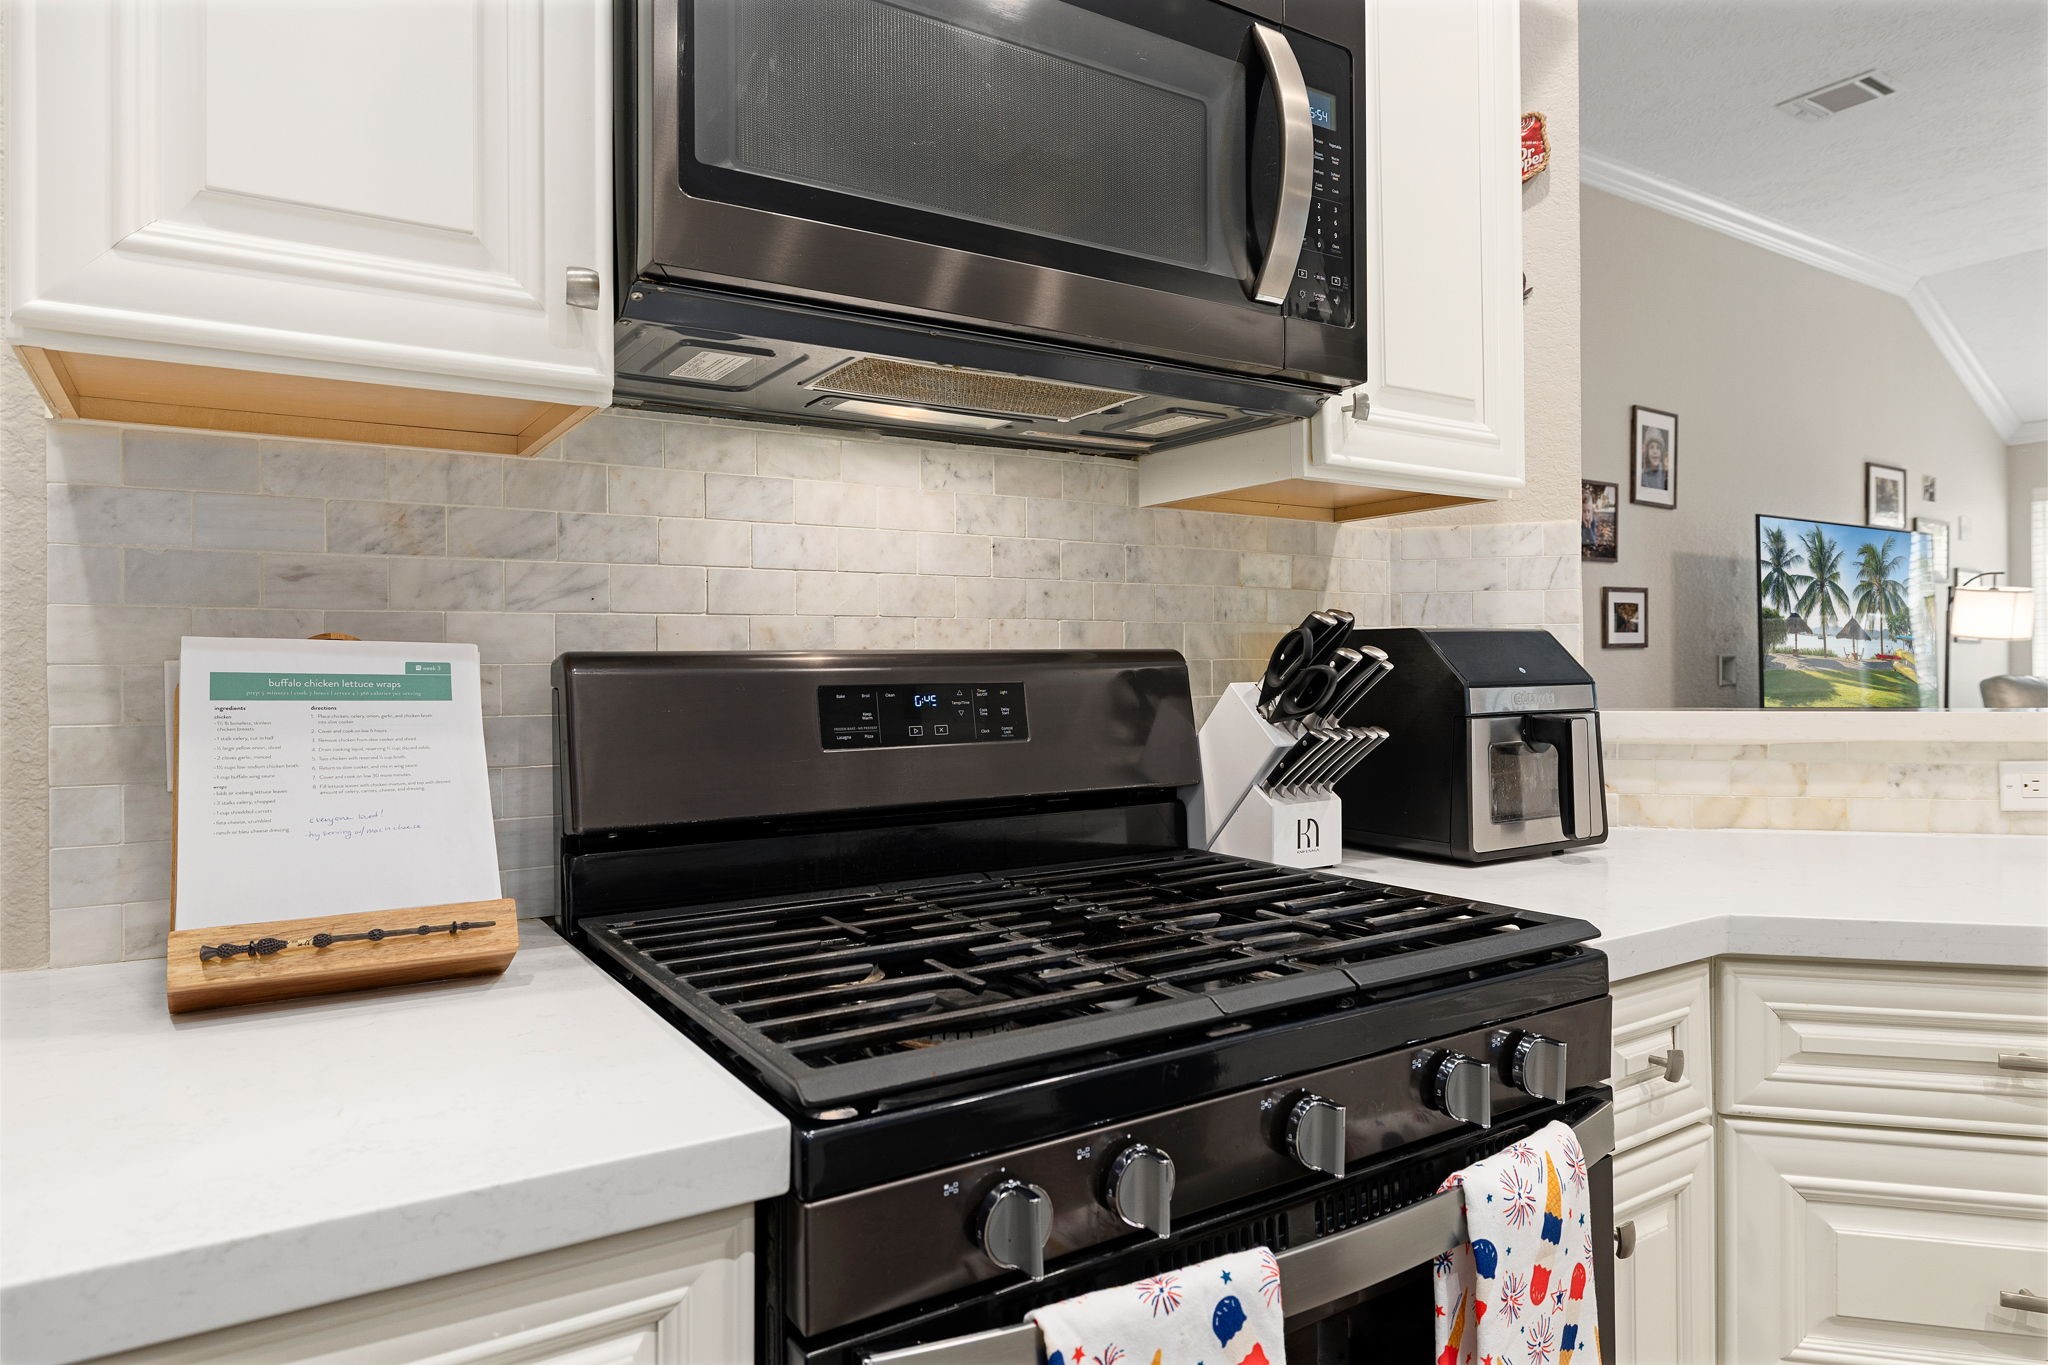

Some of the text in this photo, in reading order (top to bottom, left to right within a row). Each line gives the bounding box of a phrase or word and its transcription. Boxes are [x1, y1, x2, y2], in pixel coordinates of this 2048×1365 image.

[268, 678, 401, 690] buffalo chicken lettuce wraps
